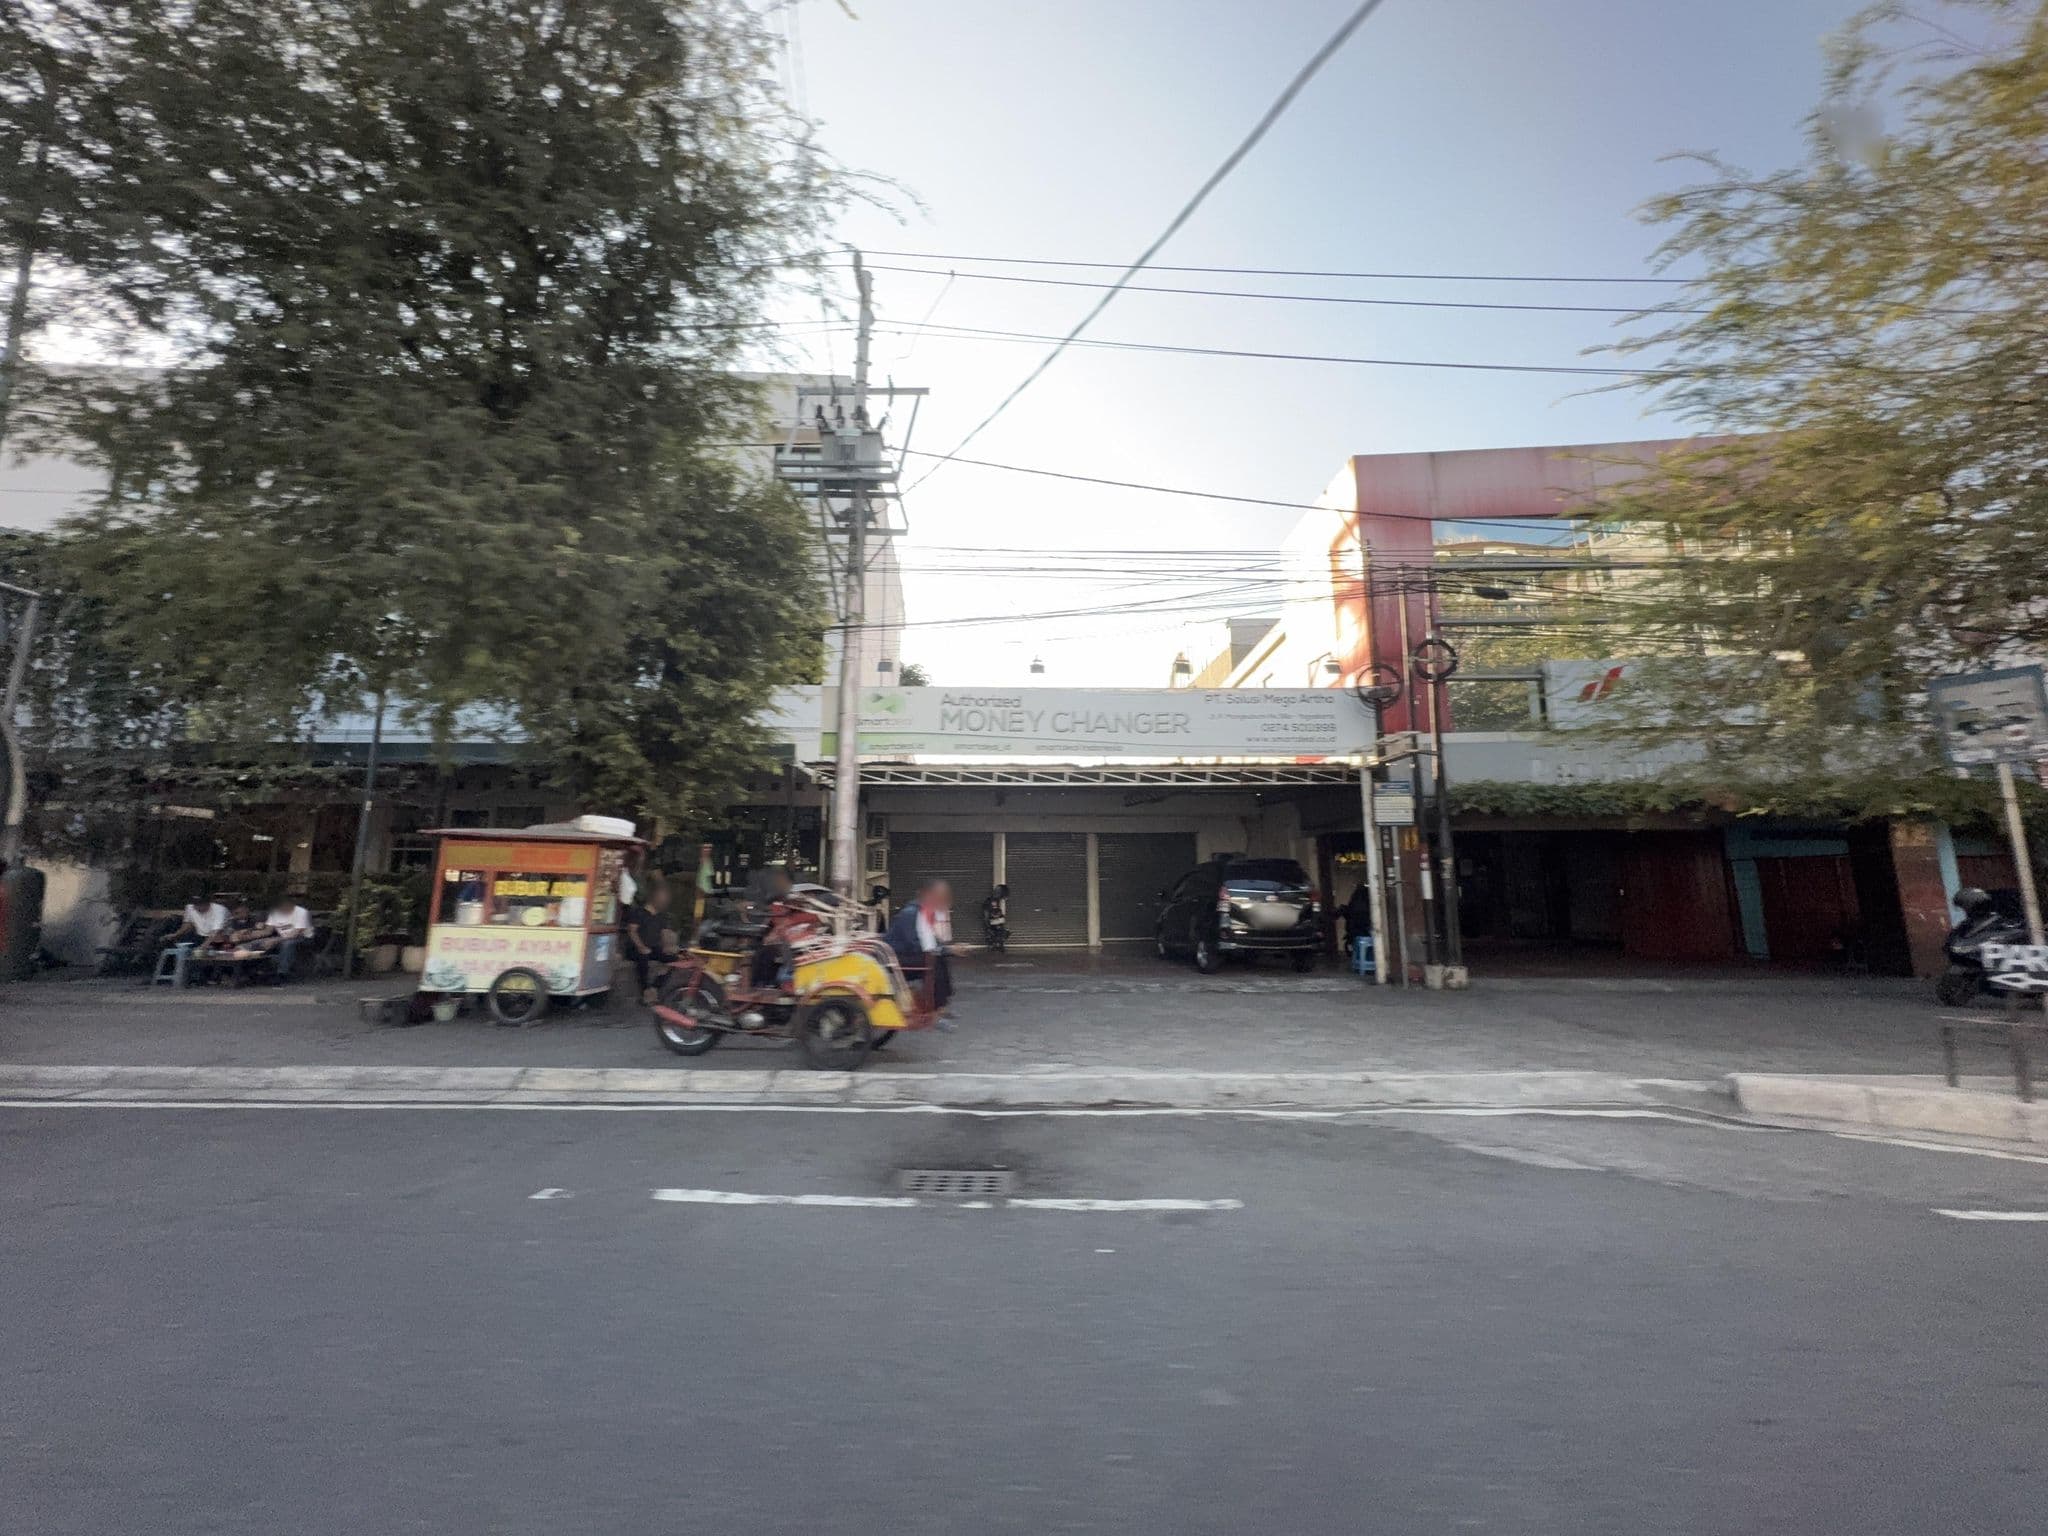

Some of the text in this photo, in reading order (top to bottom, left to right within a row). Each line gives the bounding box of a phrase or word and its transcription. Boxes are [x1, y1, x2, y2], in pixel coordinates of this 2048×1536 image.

[940, 692, 1022, 708] Authorized
[939, 710, 1044, 733] MONEY
[1052, 711, 1191, 735] CHANGER
[440, 936, 572, 954] BUBUR AYAM
